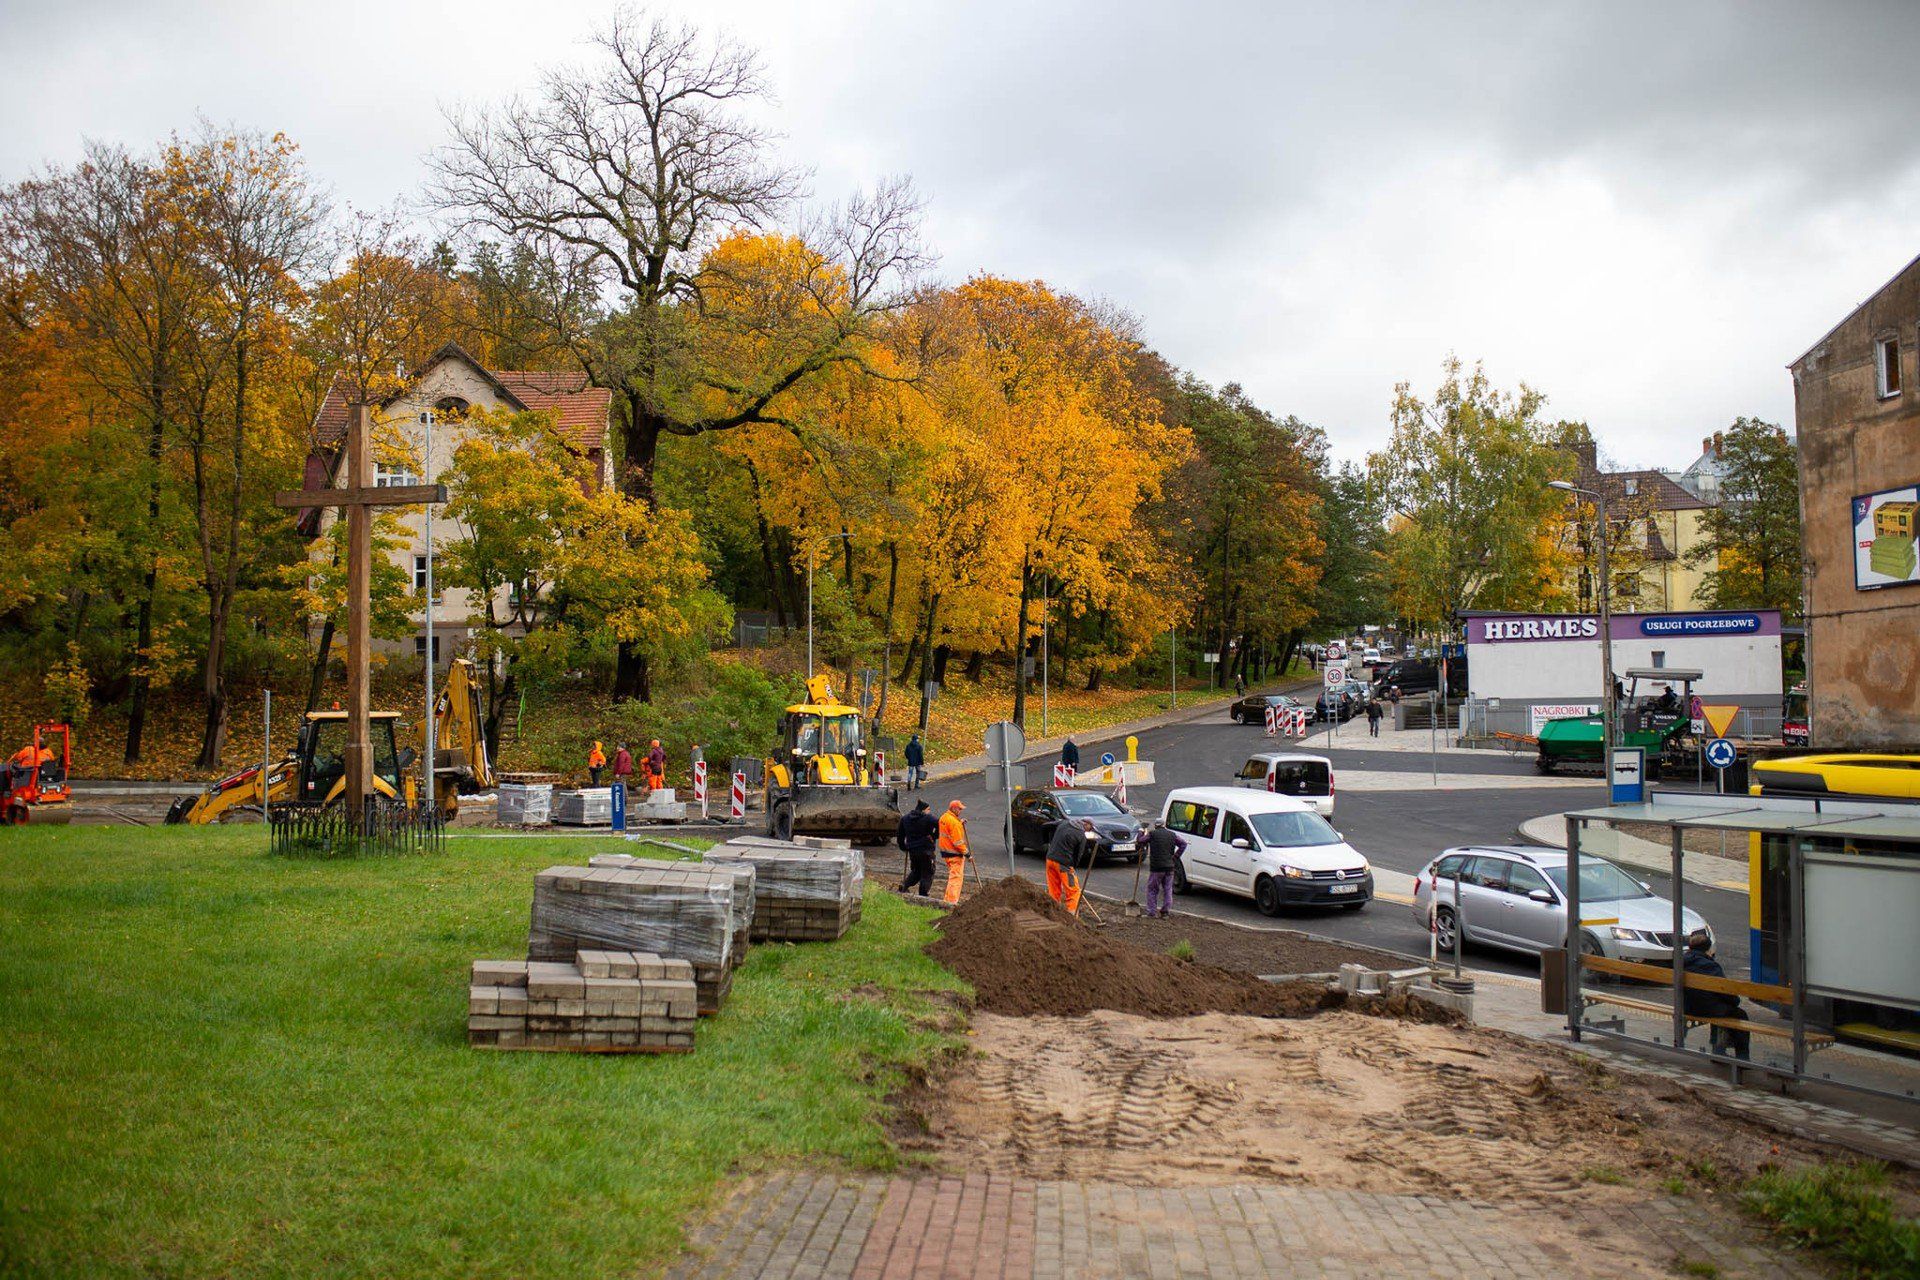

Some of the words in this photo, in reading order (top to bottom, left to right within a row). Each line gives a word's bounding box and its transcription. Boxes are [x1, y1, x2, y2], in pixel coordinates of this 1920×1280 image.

[1484, 618, 1598, 639] HERMES
[1646, 621, 1682, 630] USŁUGI
[1685, 619, 1755, 629] POGRZEBOWE
[1330, 672, 1340, 680] 30
[438, 697, 447, 711] CAT
[1534, 706, 1585, 715] NAGROBKI
